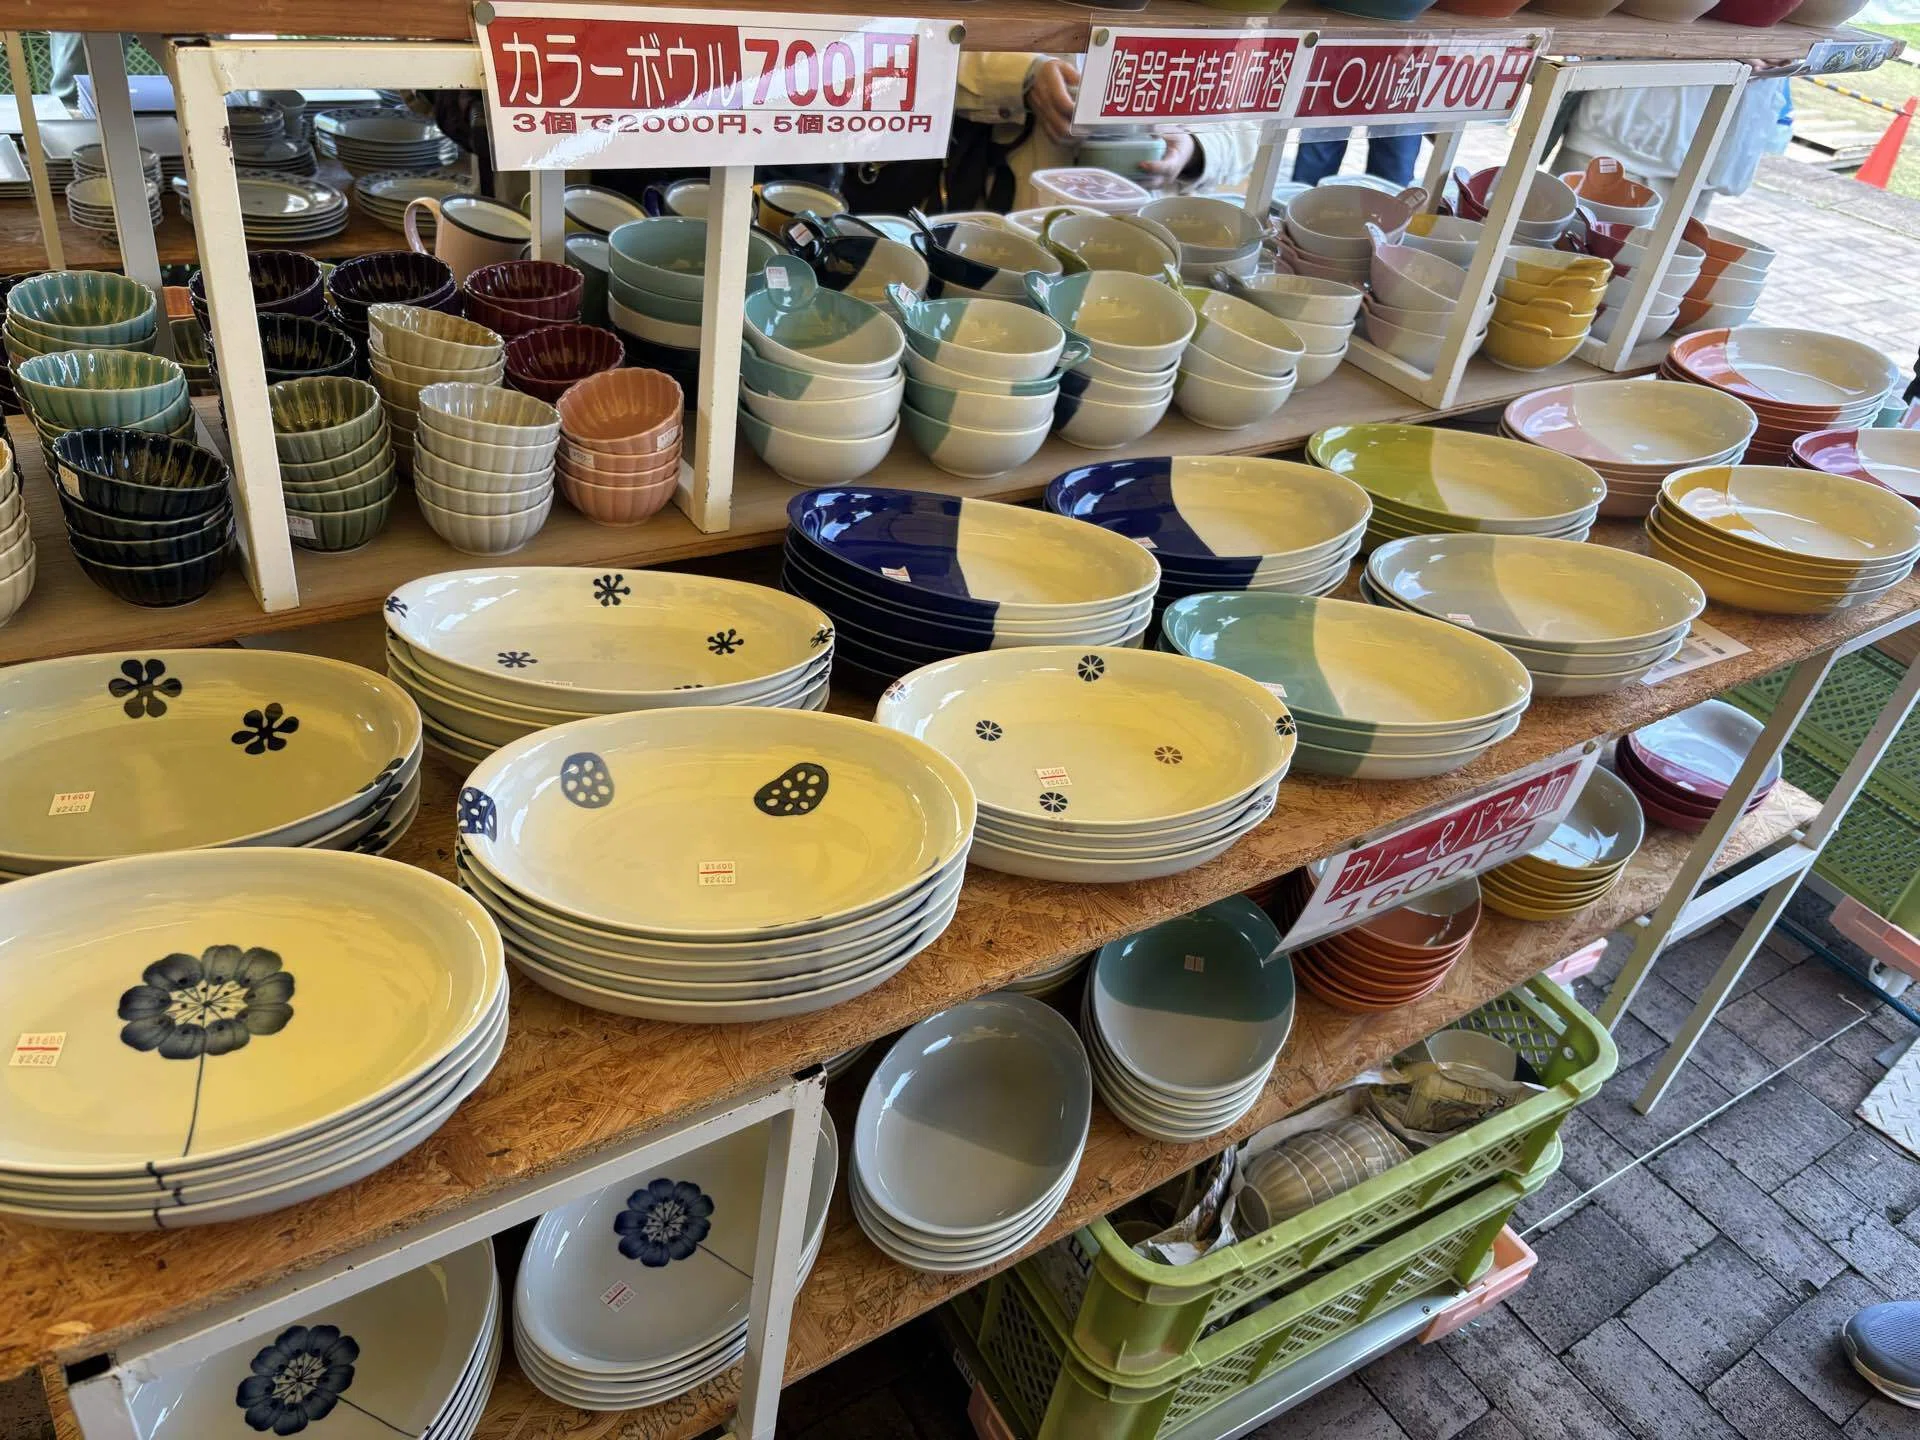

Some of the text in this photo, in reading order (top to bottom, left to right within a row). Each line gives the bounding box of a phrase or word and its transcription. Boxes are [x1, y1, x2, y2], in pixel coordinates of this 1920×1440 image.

[1104, 47, 1294, 114] 陶器市特別価格
